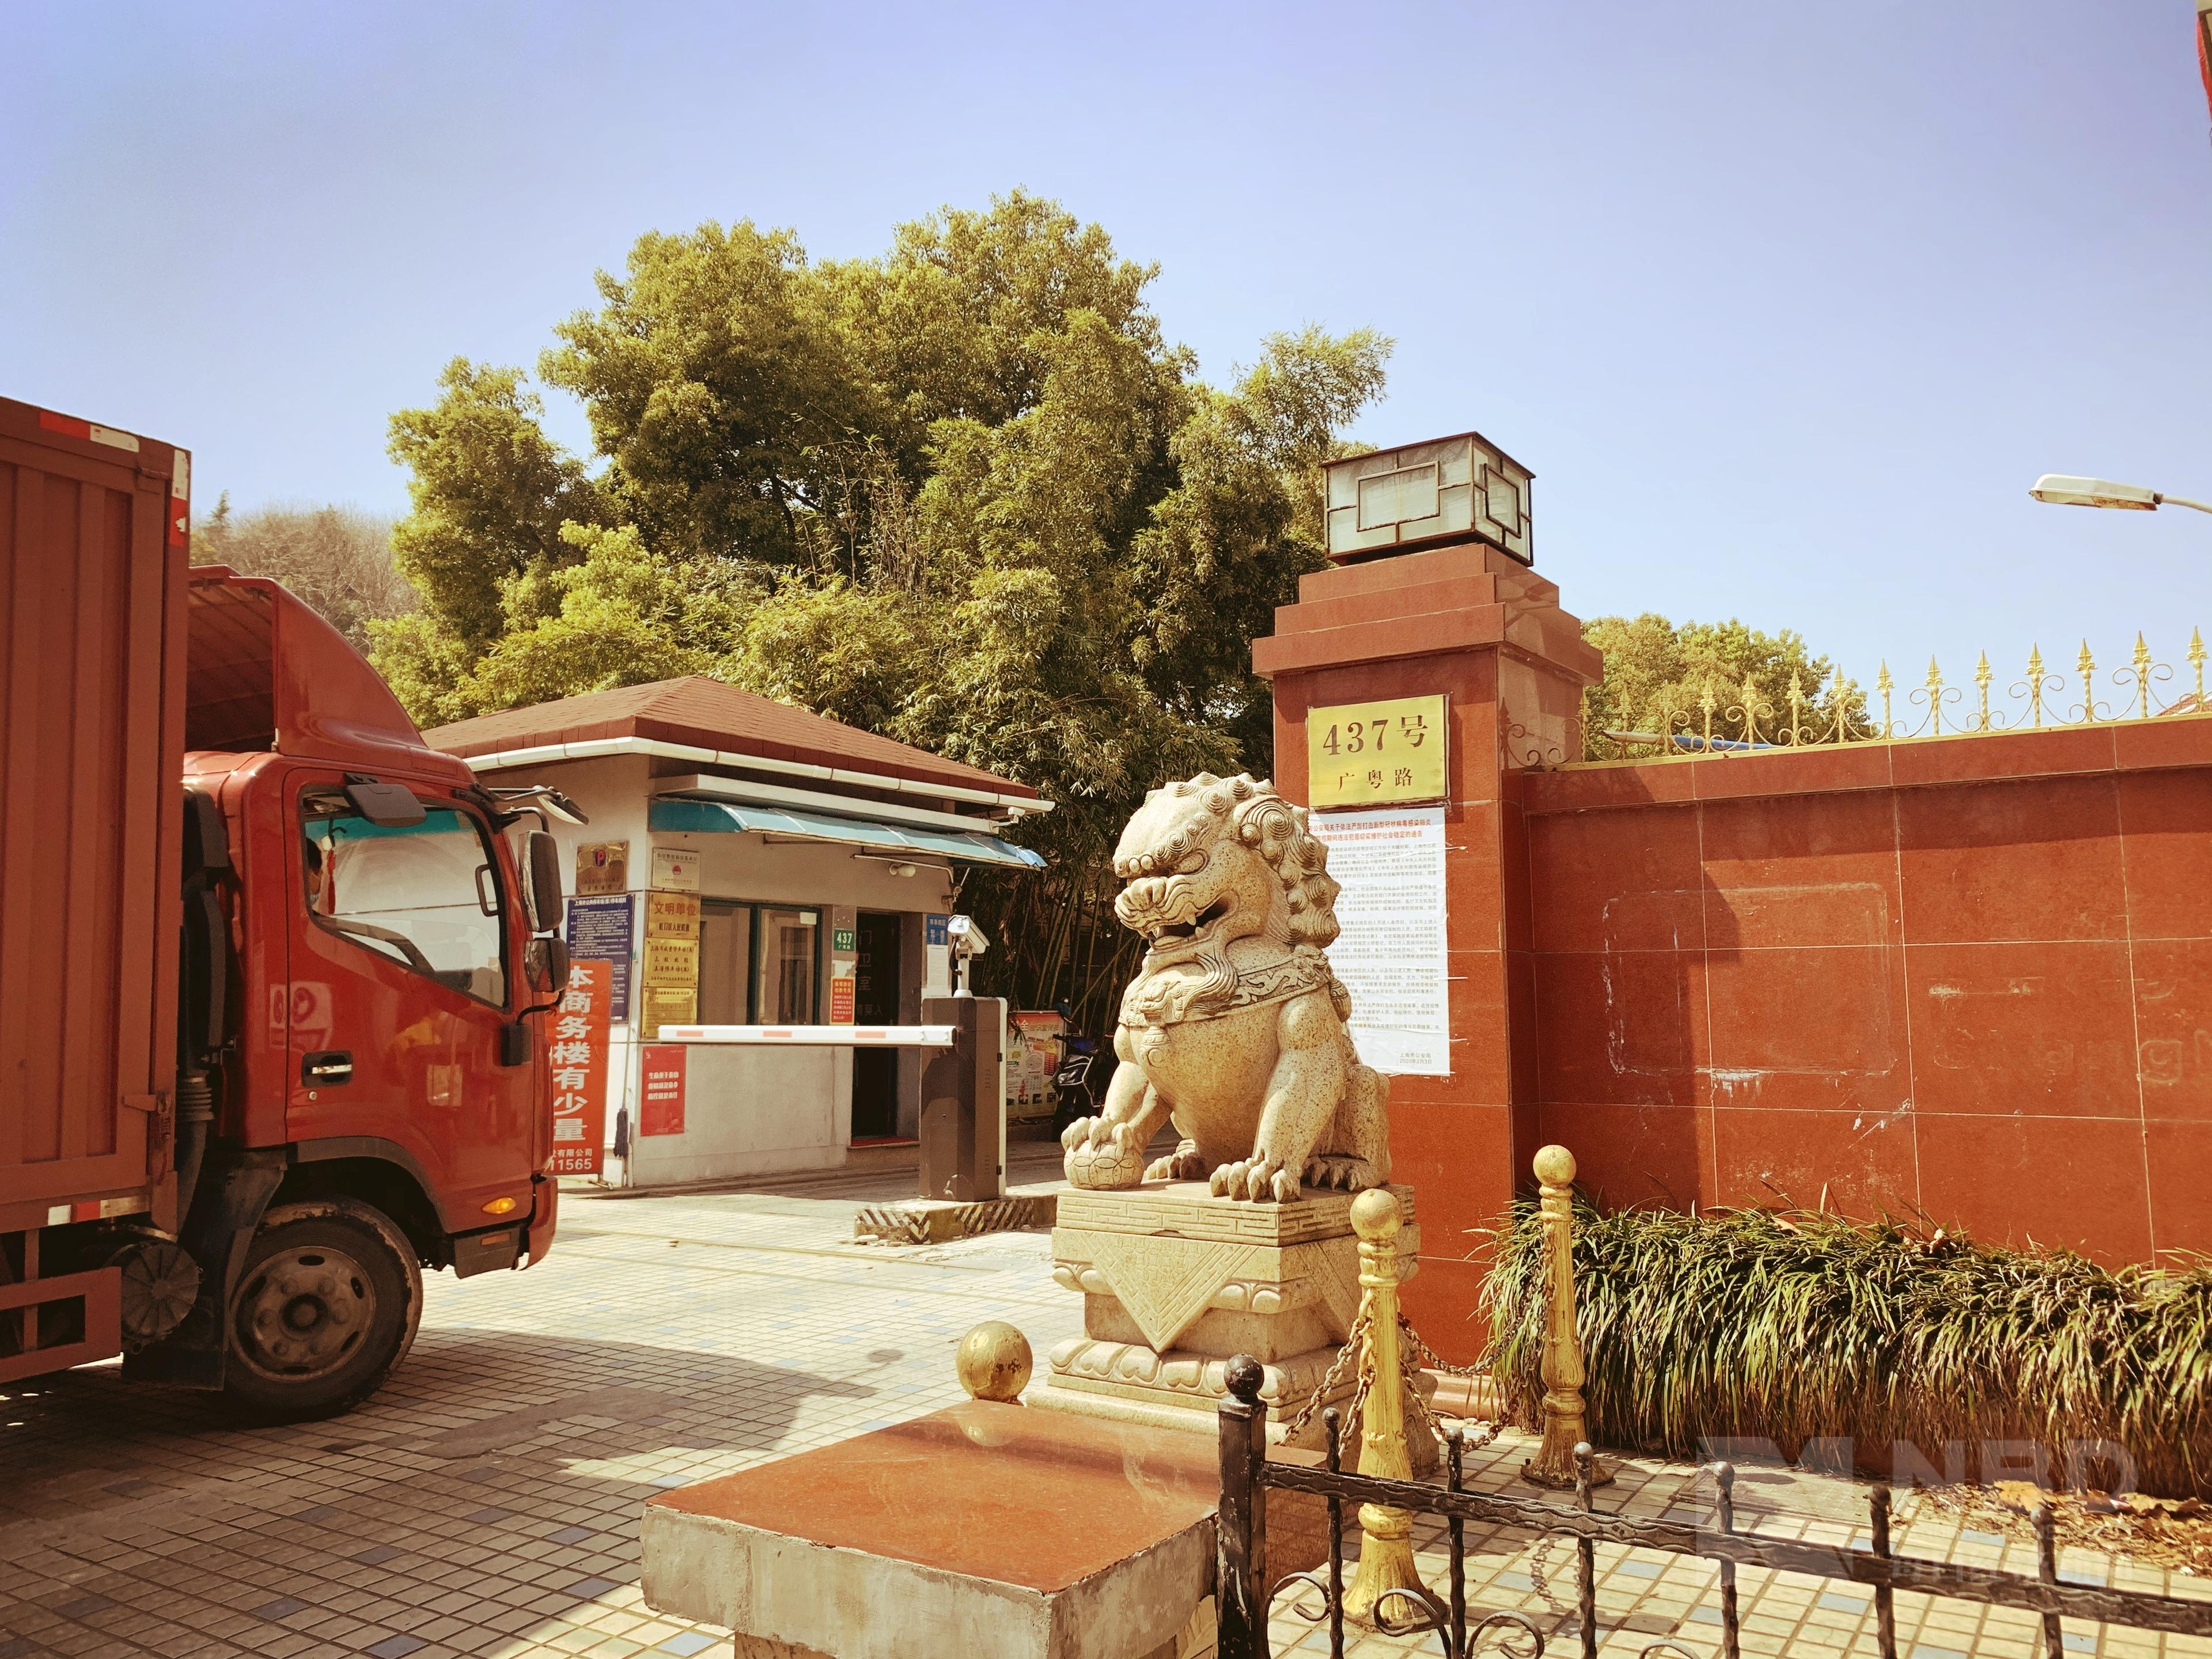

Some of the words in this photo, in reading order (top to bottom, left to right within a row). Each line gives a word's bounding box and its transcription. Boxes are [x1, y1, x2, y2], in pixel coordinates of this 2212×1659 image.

[1323, 714, 1429, 756] 437号
[1338, 767, 1414, 791] 广粤路
[654, 901, 696, 916] 文明单位
[836, 931, 853, 945] 437
[553, 965, 594, 1142] 本商务楼有少量
